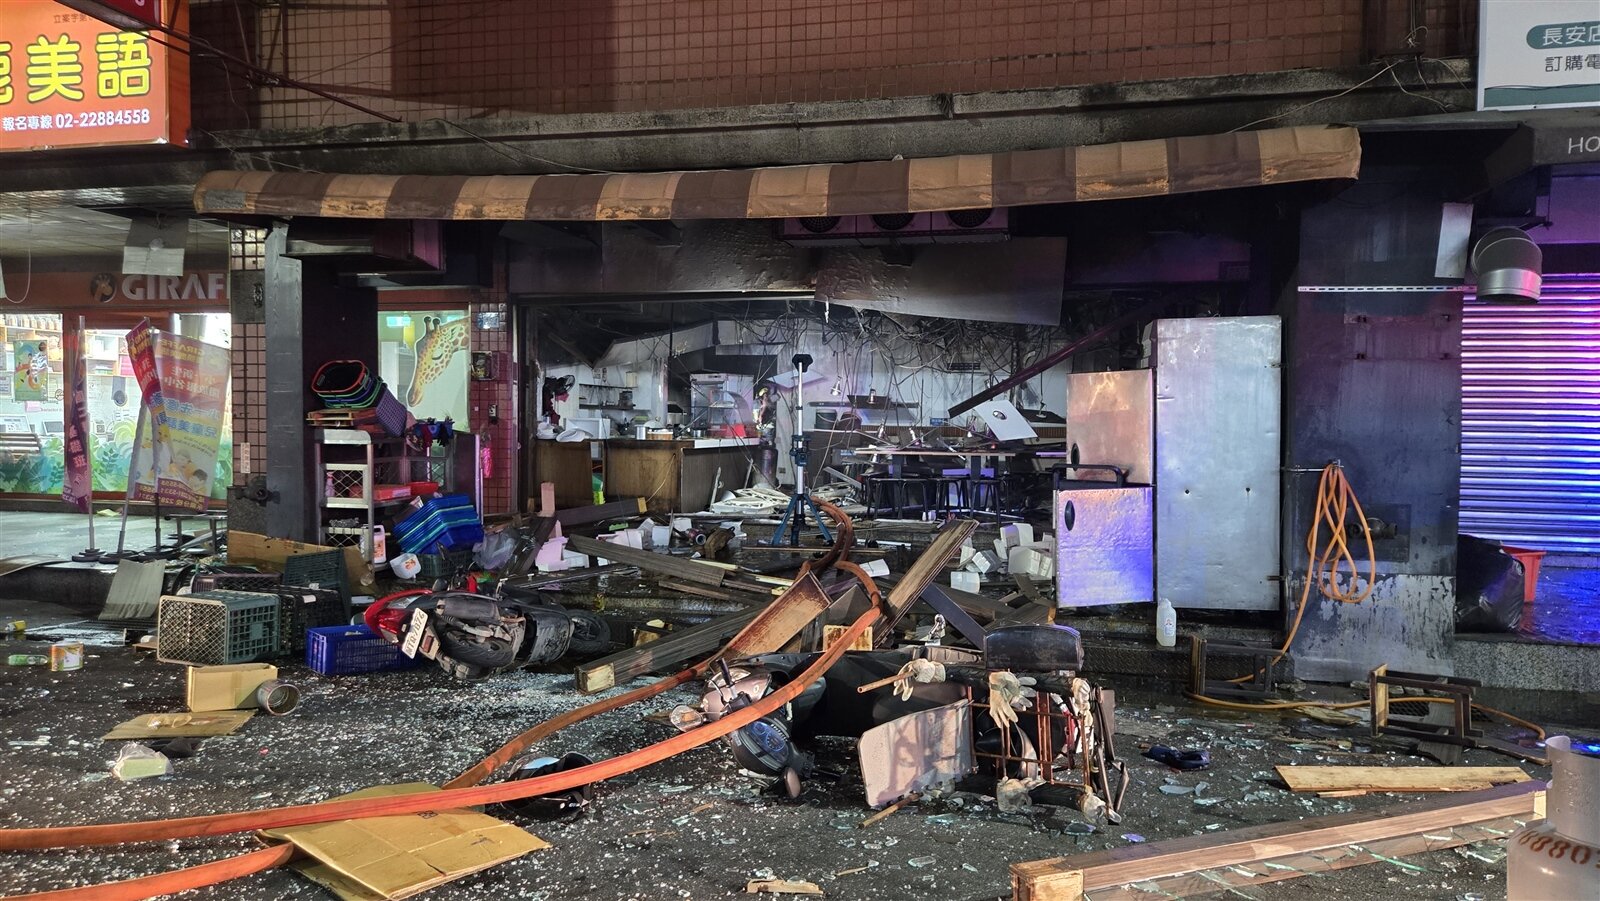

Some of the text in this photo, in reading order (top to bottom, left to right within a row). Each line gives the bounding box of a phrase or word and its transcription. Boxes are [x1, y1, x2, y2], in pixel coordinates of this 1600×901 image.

[1543, 25, 1600, 46] 長安店
[0, 31, 151, 104] 美語
[1545, 54, 1600, 73] 訂購電
[2, 108, 150, 132] 報名專線 02-22884558
[122, 272, 229, 300] GIRAF
